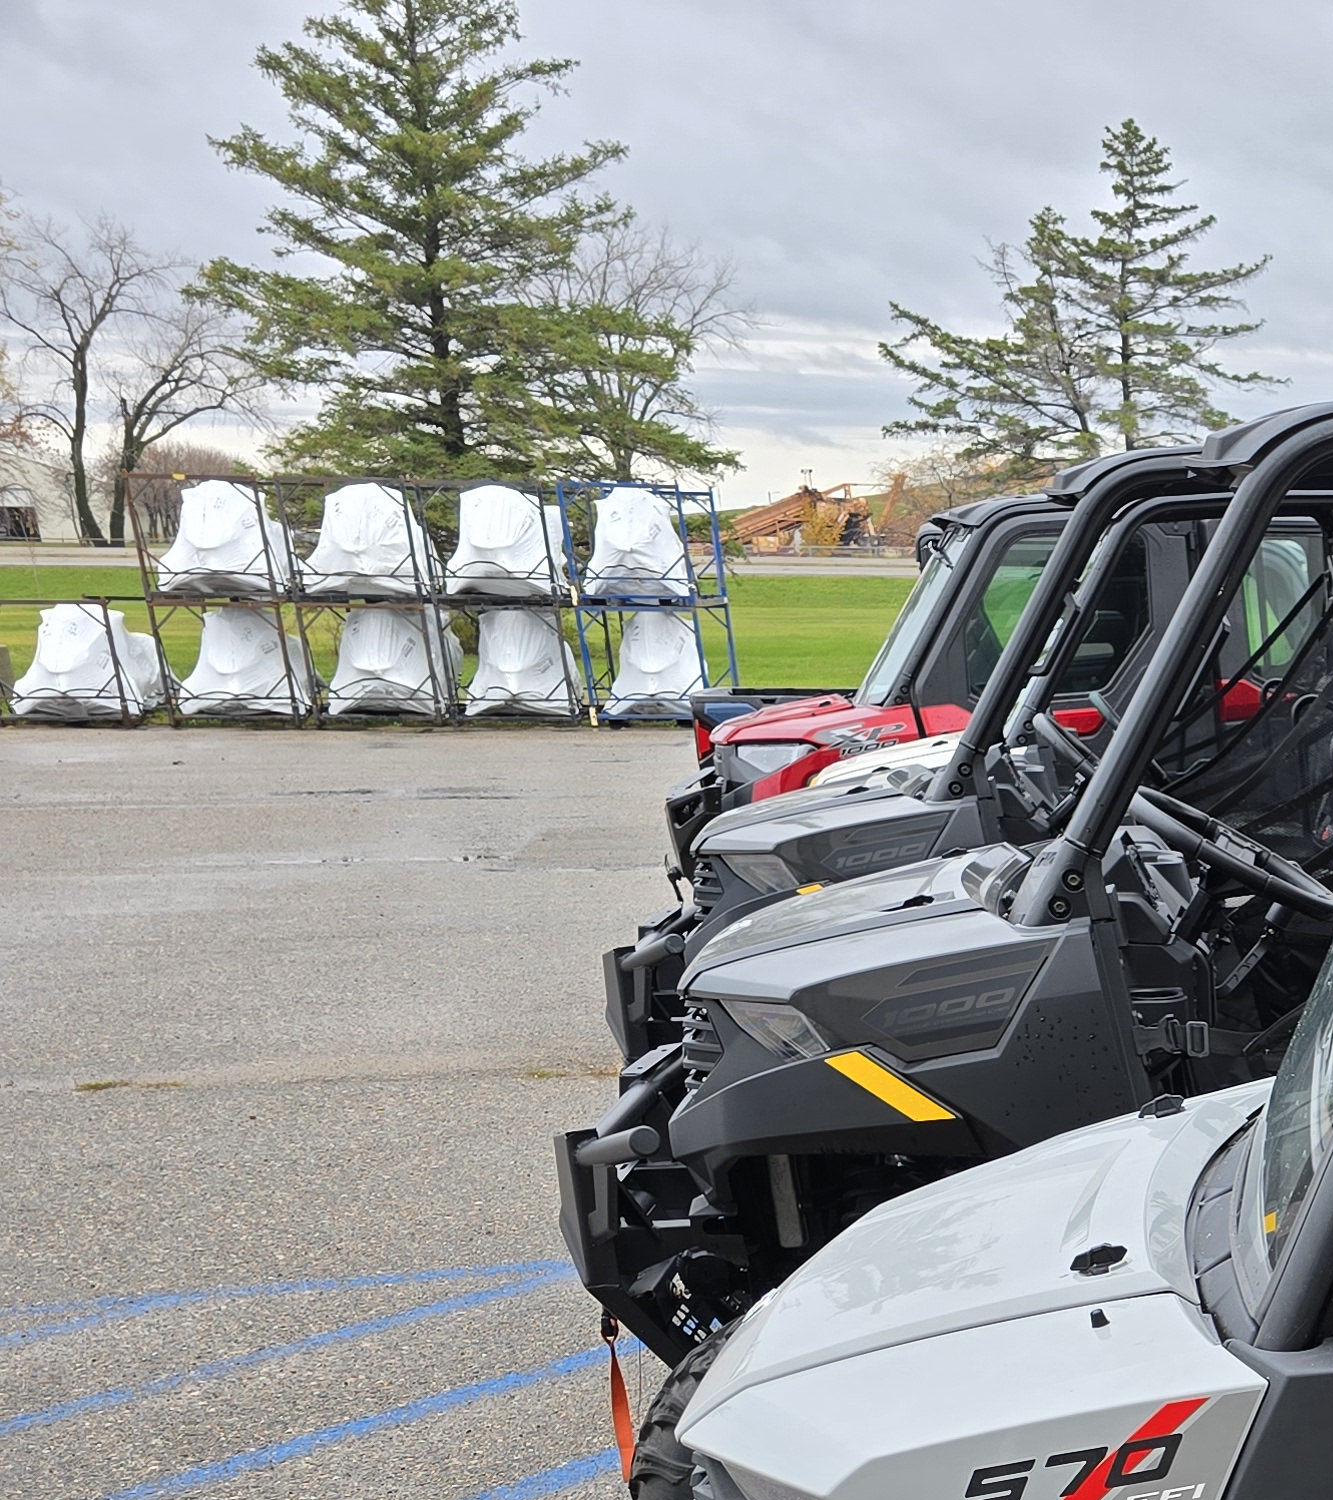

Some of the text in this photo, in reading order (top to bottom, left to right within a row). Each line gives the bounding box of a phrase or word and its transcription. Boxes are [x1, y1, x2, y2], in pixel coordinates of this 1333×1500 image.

[829, 723, 906, 748] XP
[840, 739, 898, 756] 1000
[836, 842, 926, 869] 1000
[883, 987, 1016, 1028] 1000
